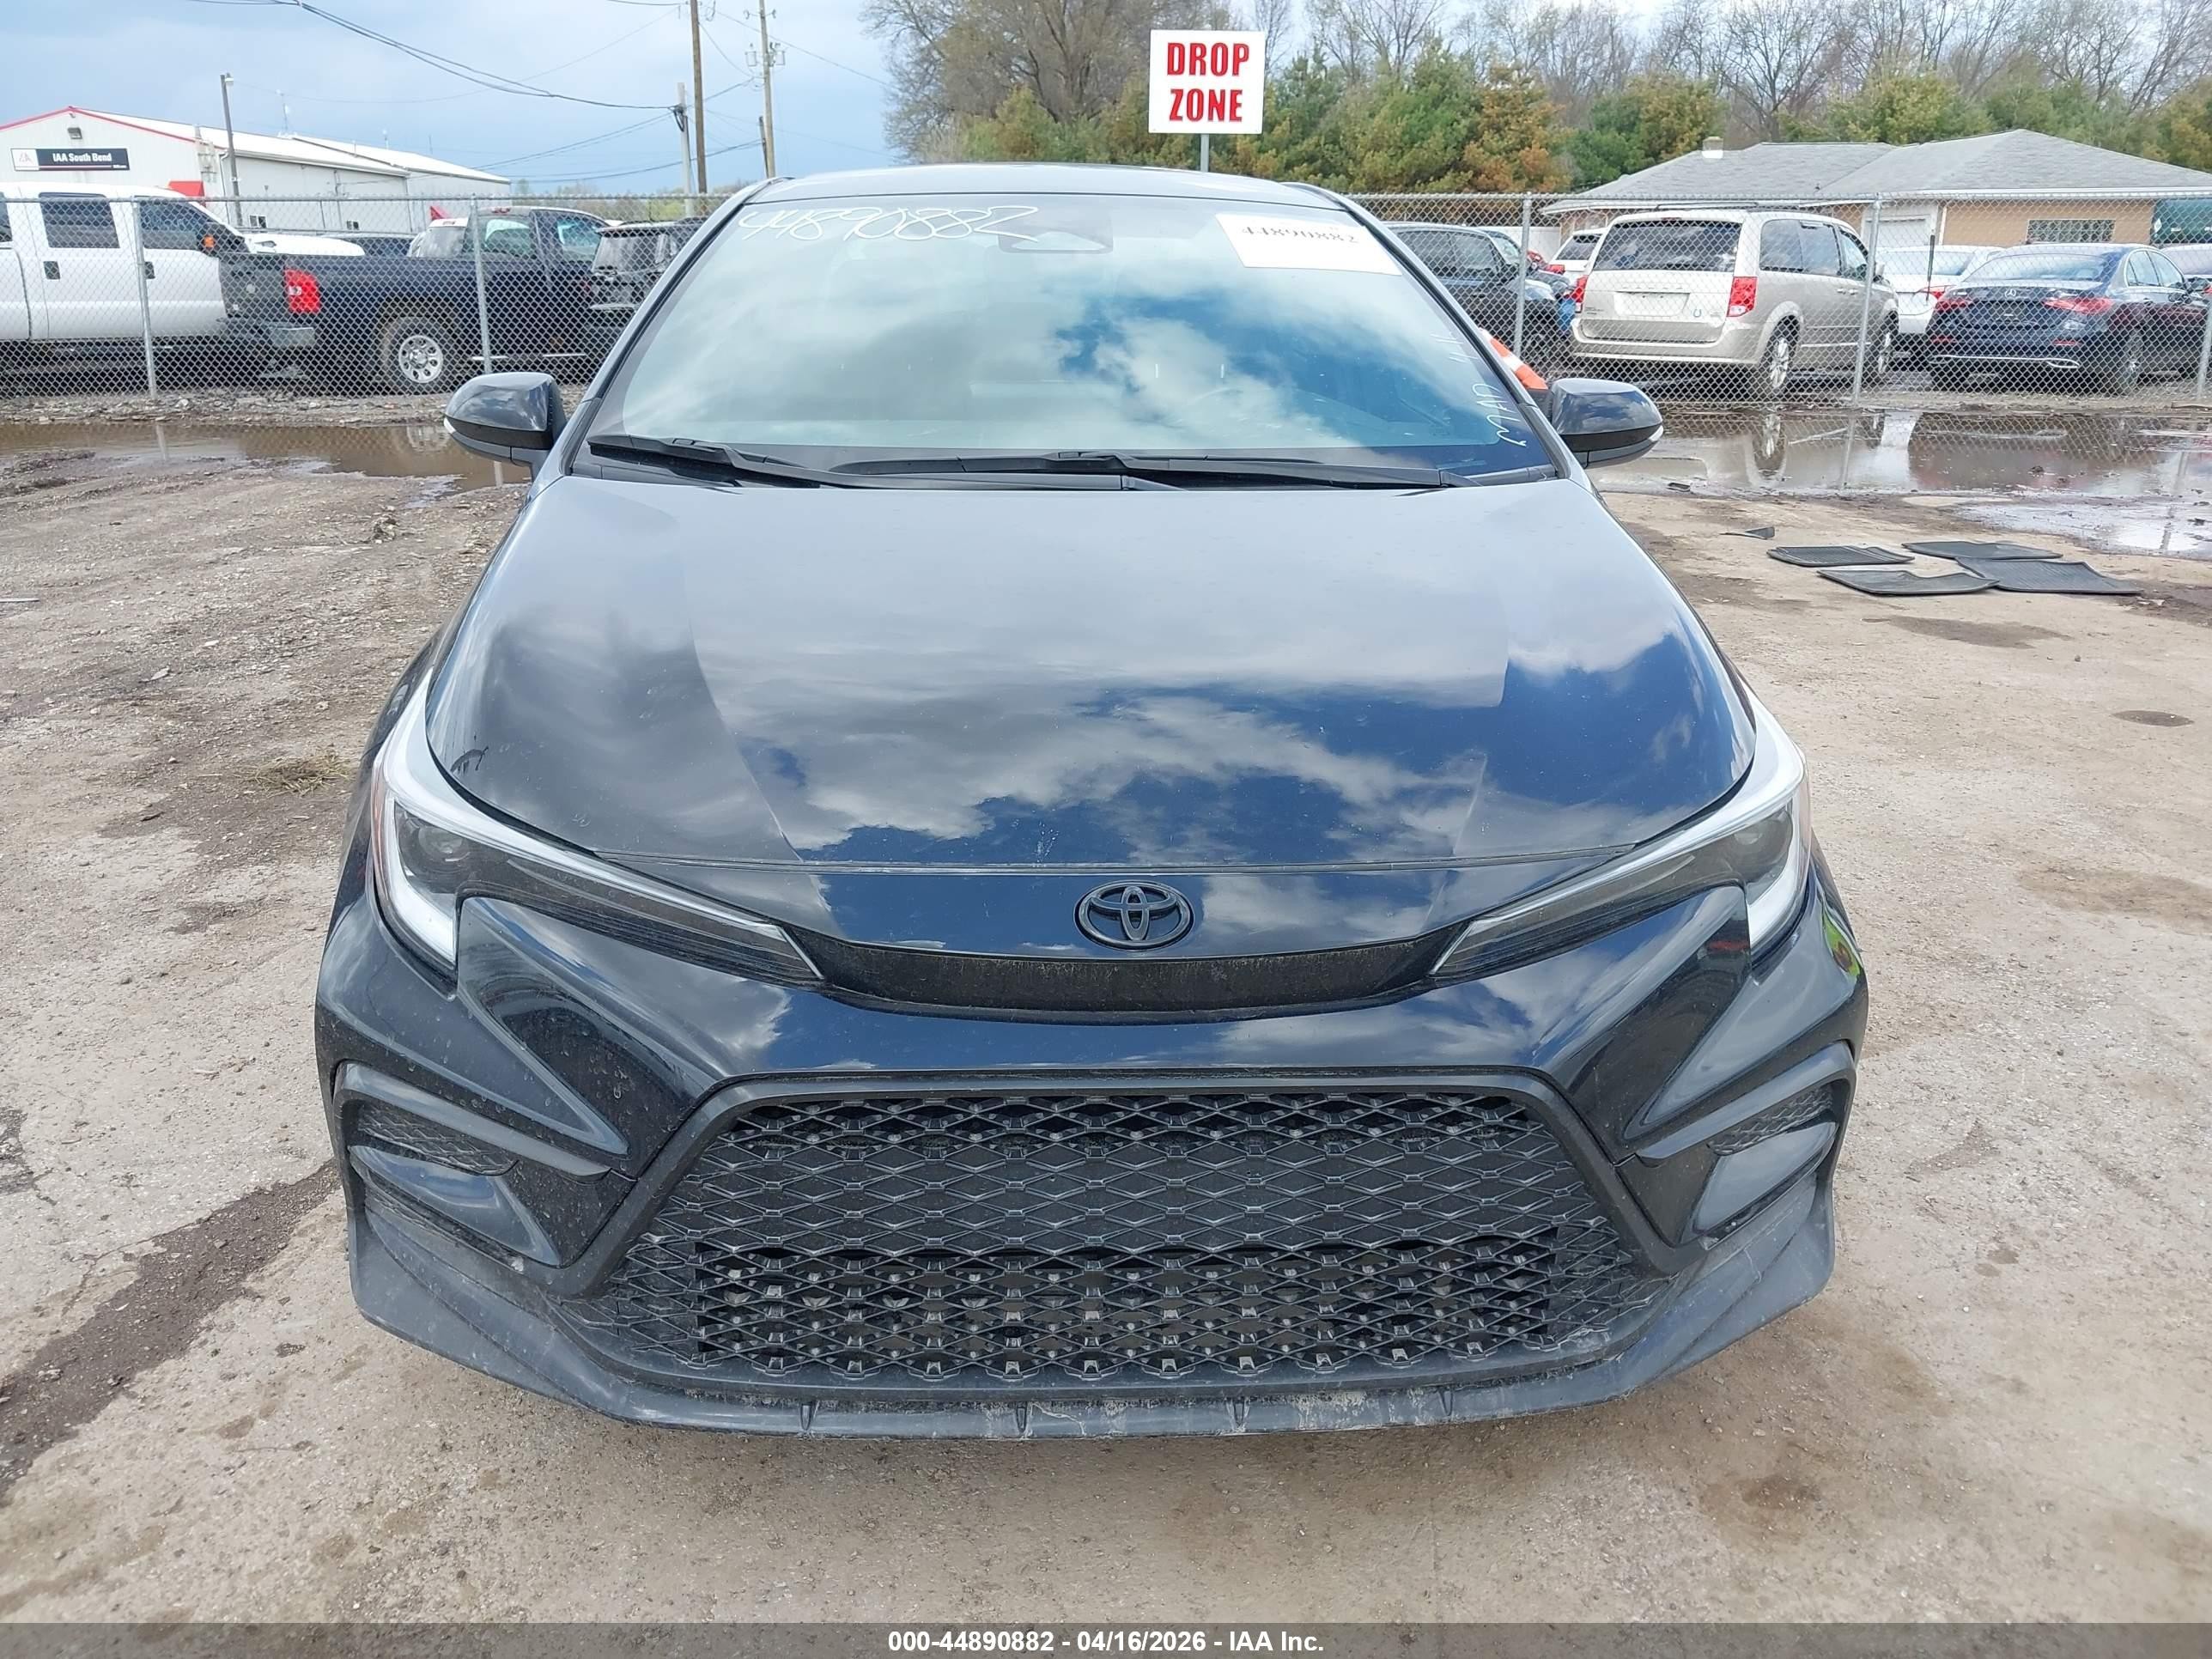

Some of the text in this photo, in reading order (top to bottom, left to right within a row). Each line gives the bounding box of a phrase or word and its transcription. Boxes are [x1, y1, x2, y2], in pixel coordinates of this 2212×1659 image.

[1167, 42, 1249, 76] DROP
[1169, 88, 1243, 122] ZONE
[52, 153, 112, 162] IAA South Bend
[738, 205, 1040, 243] 44890882
